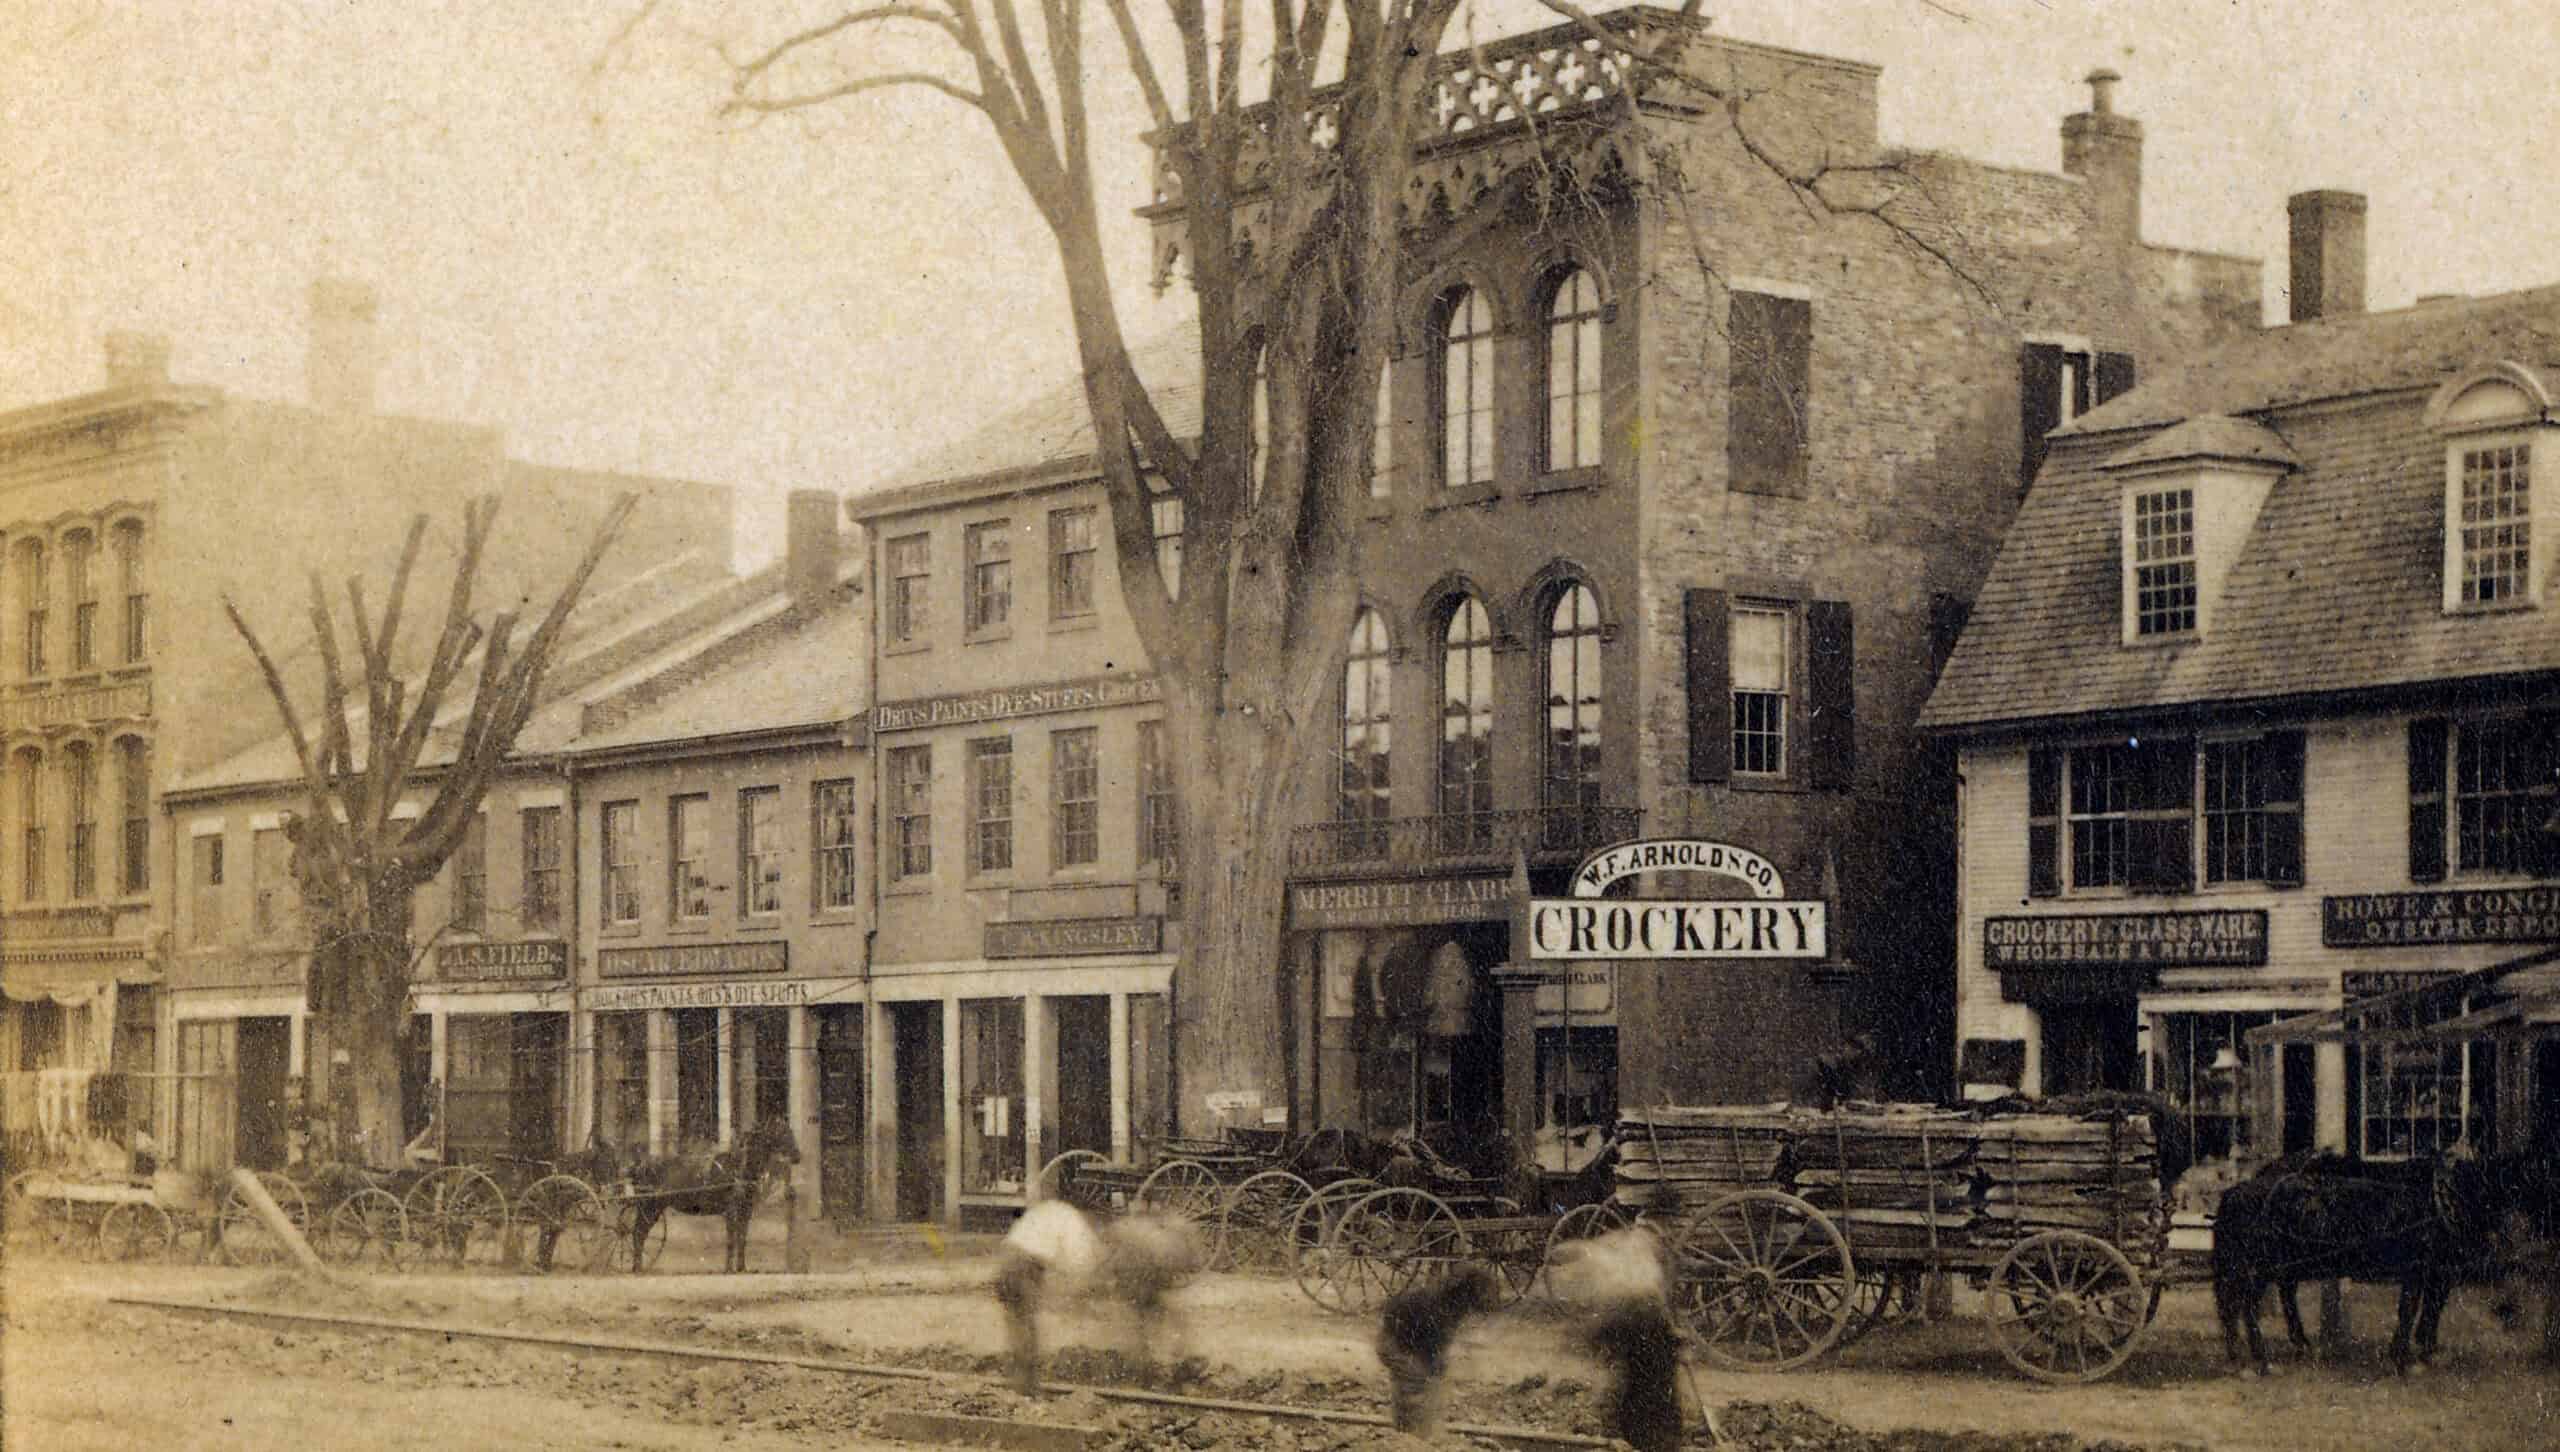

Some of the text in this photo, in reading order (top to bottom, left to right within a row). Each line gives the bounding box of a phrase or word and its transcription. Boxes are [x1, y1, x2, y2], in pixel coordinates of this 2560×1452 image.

[1534, 906, 1814, 952] CROCKERY
[1988, 918, 2101, 945] CROCKERY
[1999, 944, 2131, 960] WHOLESALE
